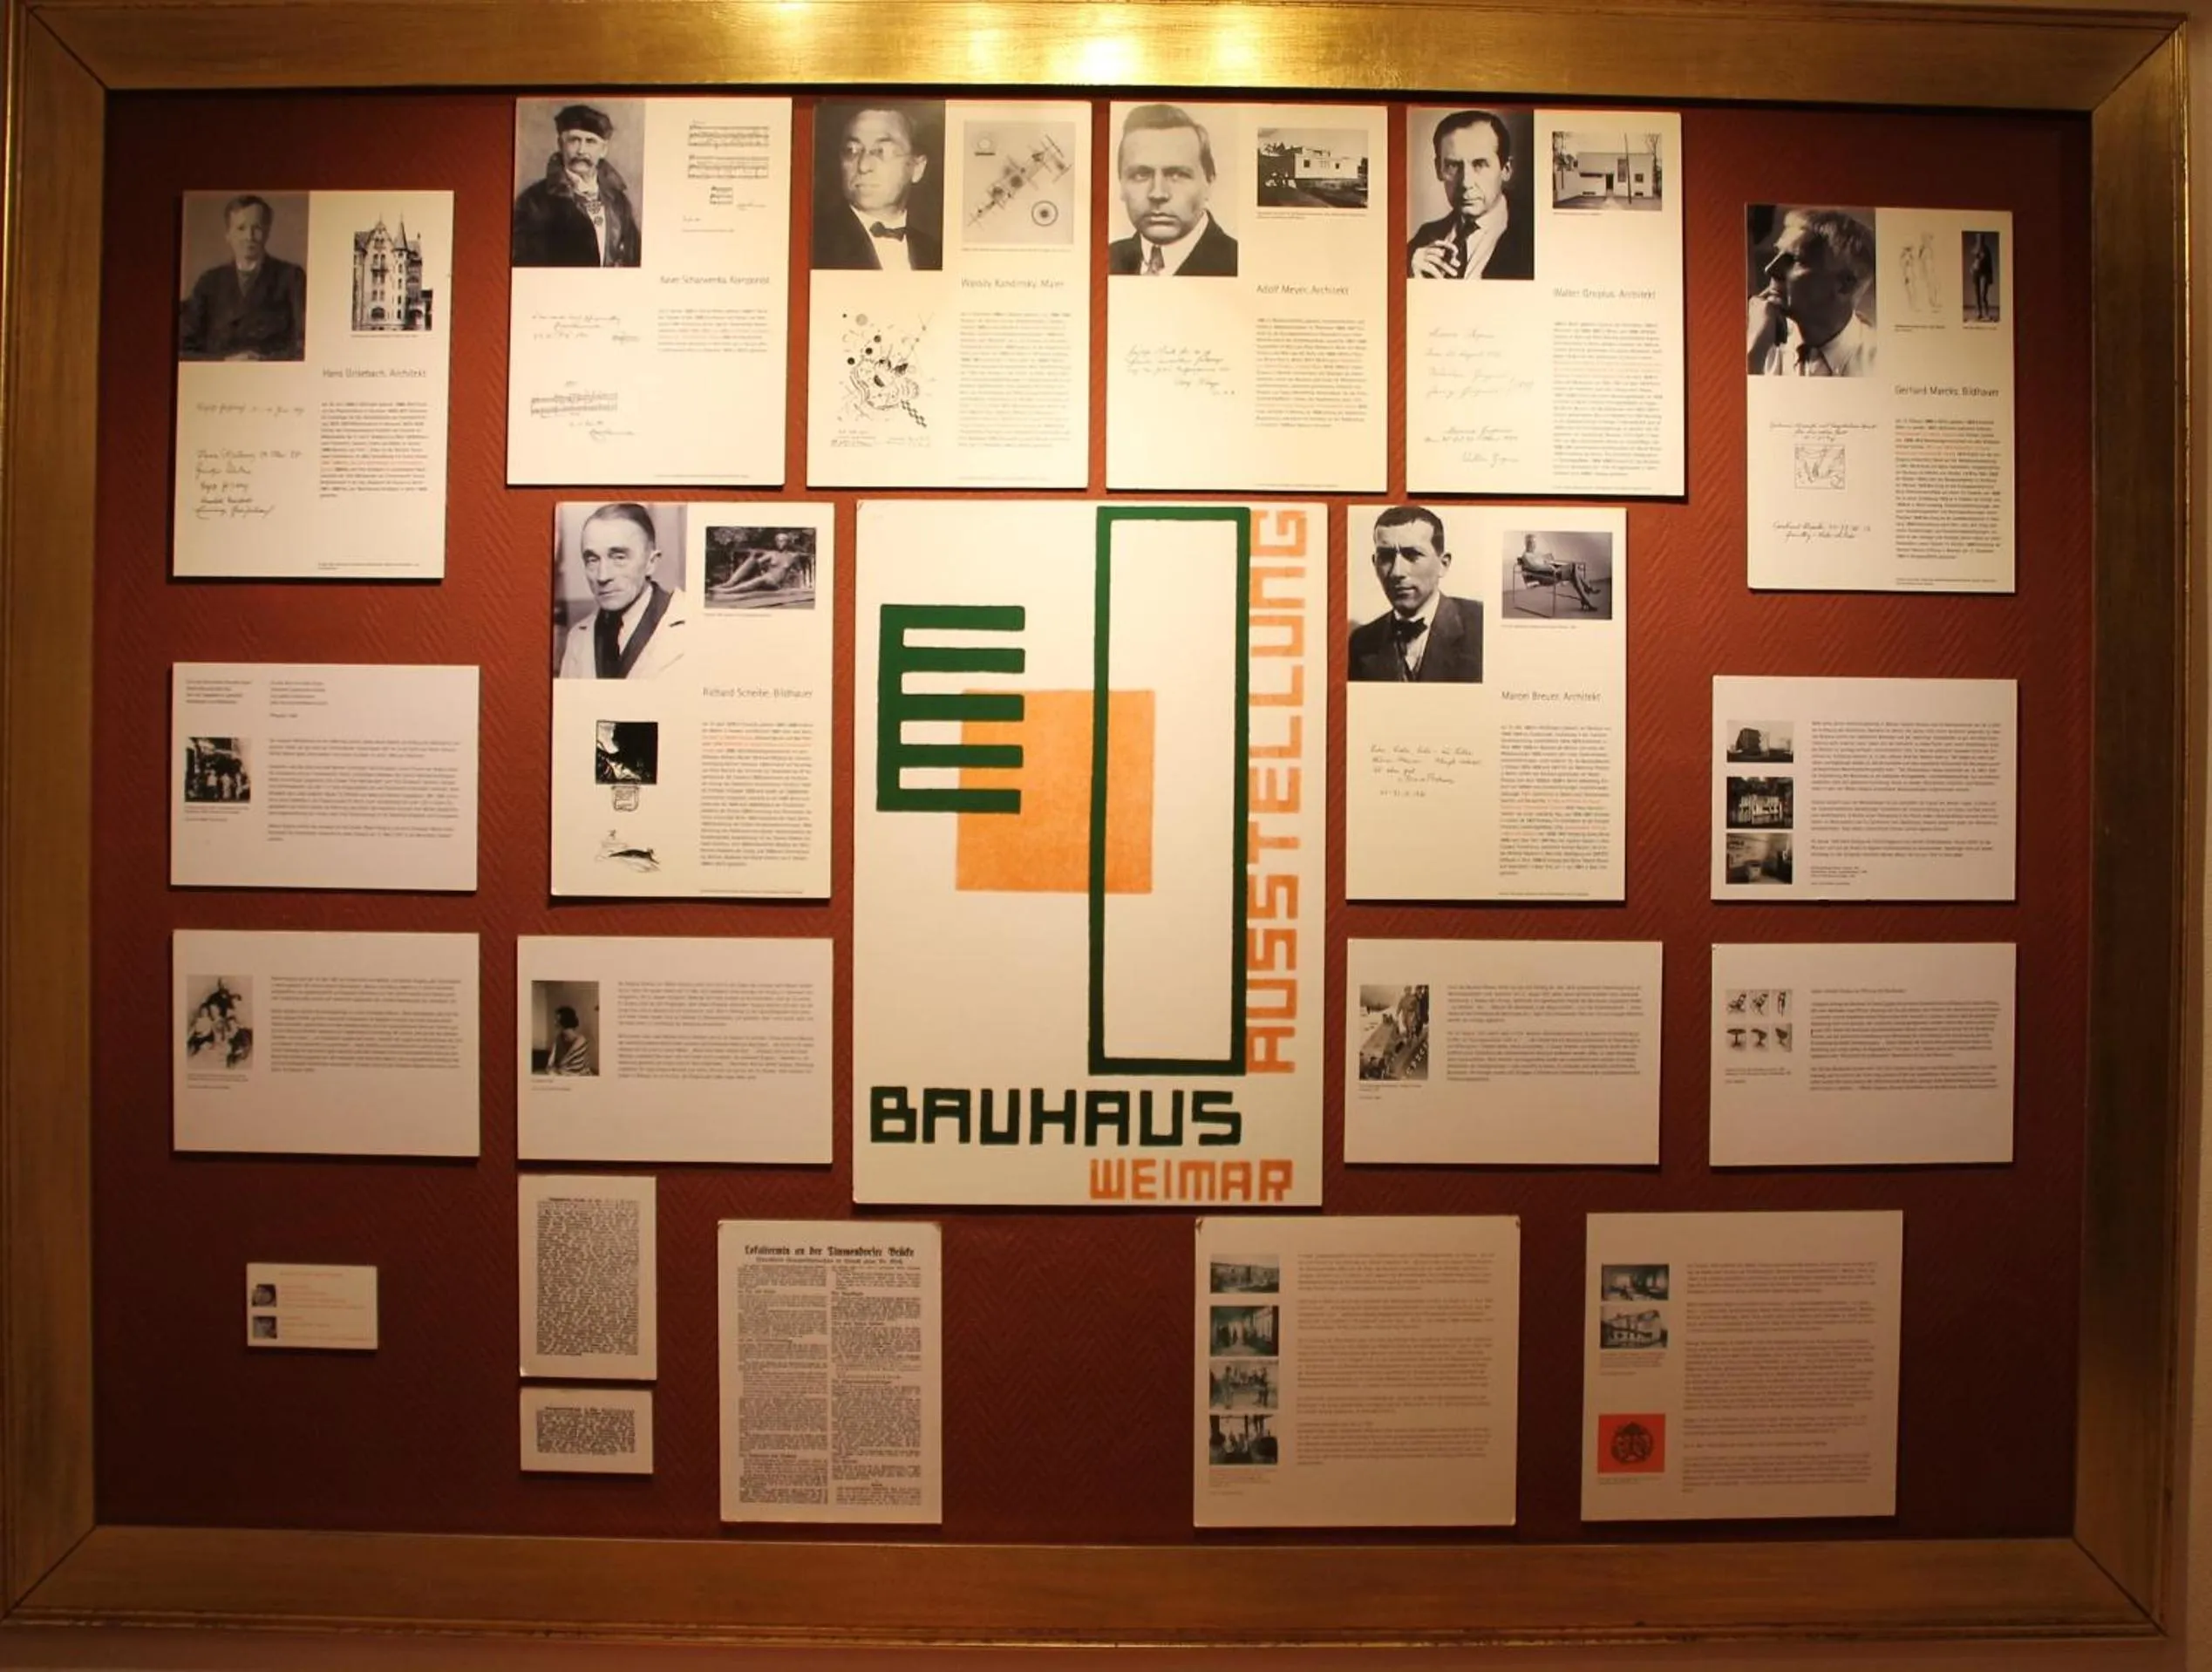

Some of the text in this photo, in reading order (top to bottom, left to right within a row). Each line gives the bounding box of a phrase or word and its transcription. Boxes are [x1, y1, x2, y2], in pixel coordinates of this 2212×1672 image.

[1256, 284, 1280, 295] Adolf
[1311, 284, 1350, 296] Architekt
[1245, 508, 1308, 1074] AUSSTELLUNG
[871, 1086, 1242, 1145] BAUHAUS
[1089, 1159, 1293, 1201] WEIMAR
